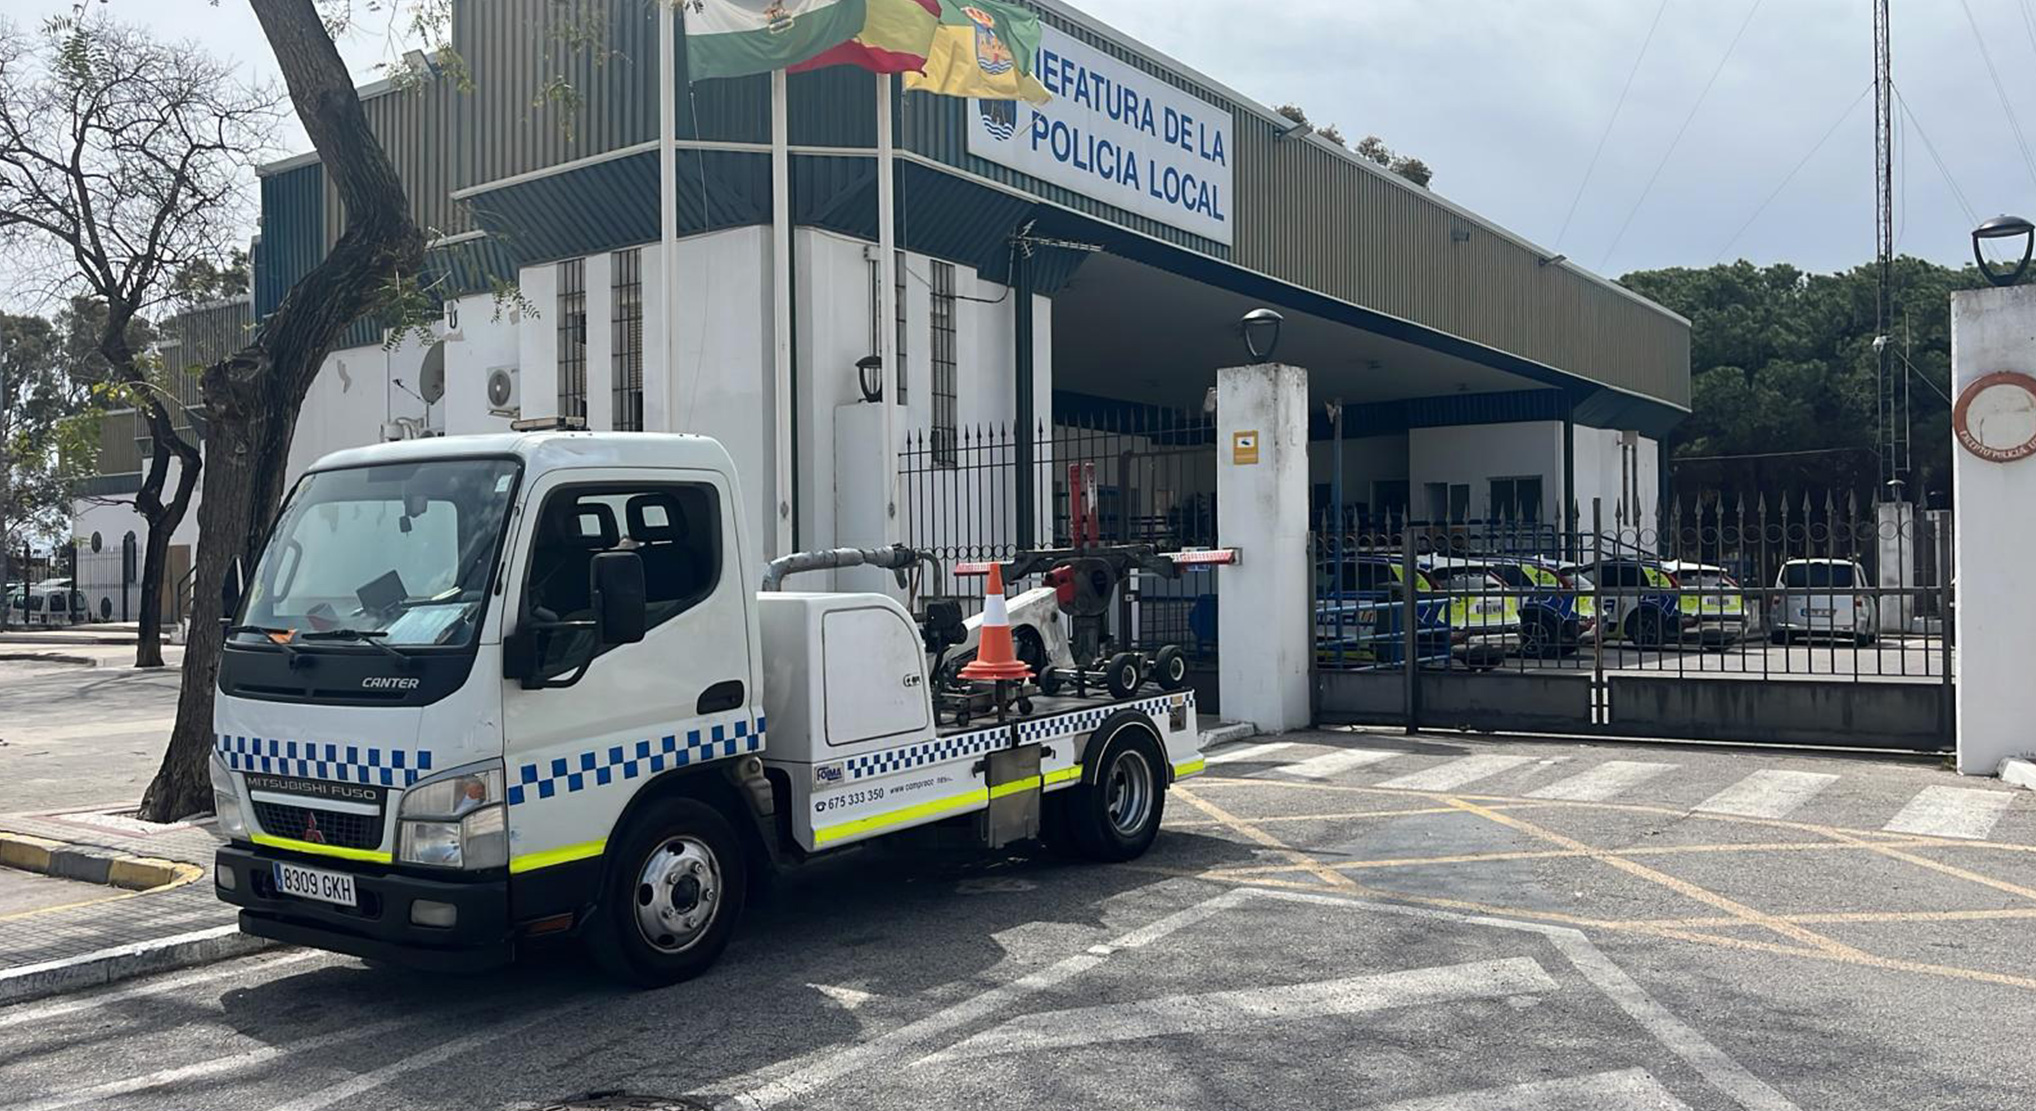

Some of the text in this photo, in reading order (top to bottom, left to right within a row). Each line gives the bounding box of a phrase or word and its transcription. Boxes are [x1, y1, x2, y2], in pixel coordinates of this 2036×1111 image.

[1164, 106, 1193, 153] DE
[1200, 123, 1226, 167] LA
[1031, 110, 1225, 222] POLICIA LOCAL
[362, 677, 420, 689] CANTER
[247, 777, 377, 800] MITSUBISHI FUSO
[828, 796, 846, 811] 675
[848, 791, 866, 806] 333
[867, 787, 884, 802] 350
[284, 867, 352, 902] 8309 GKH
